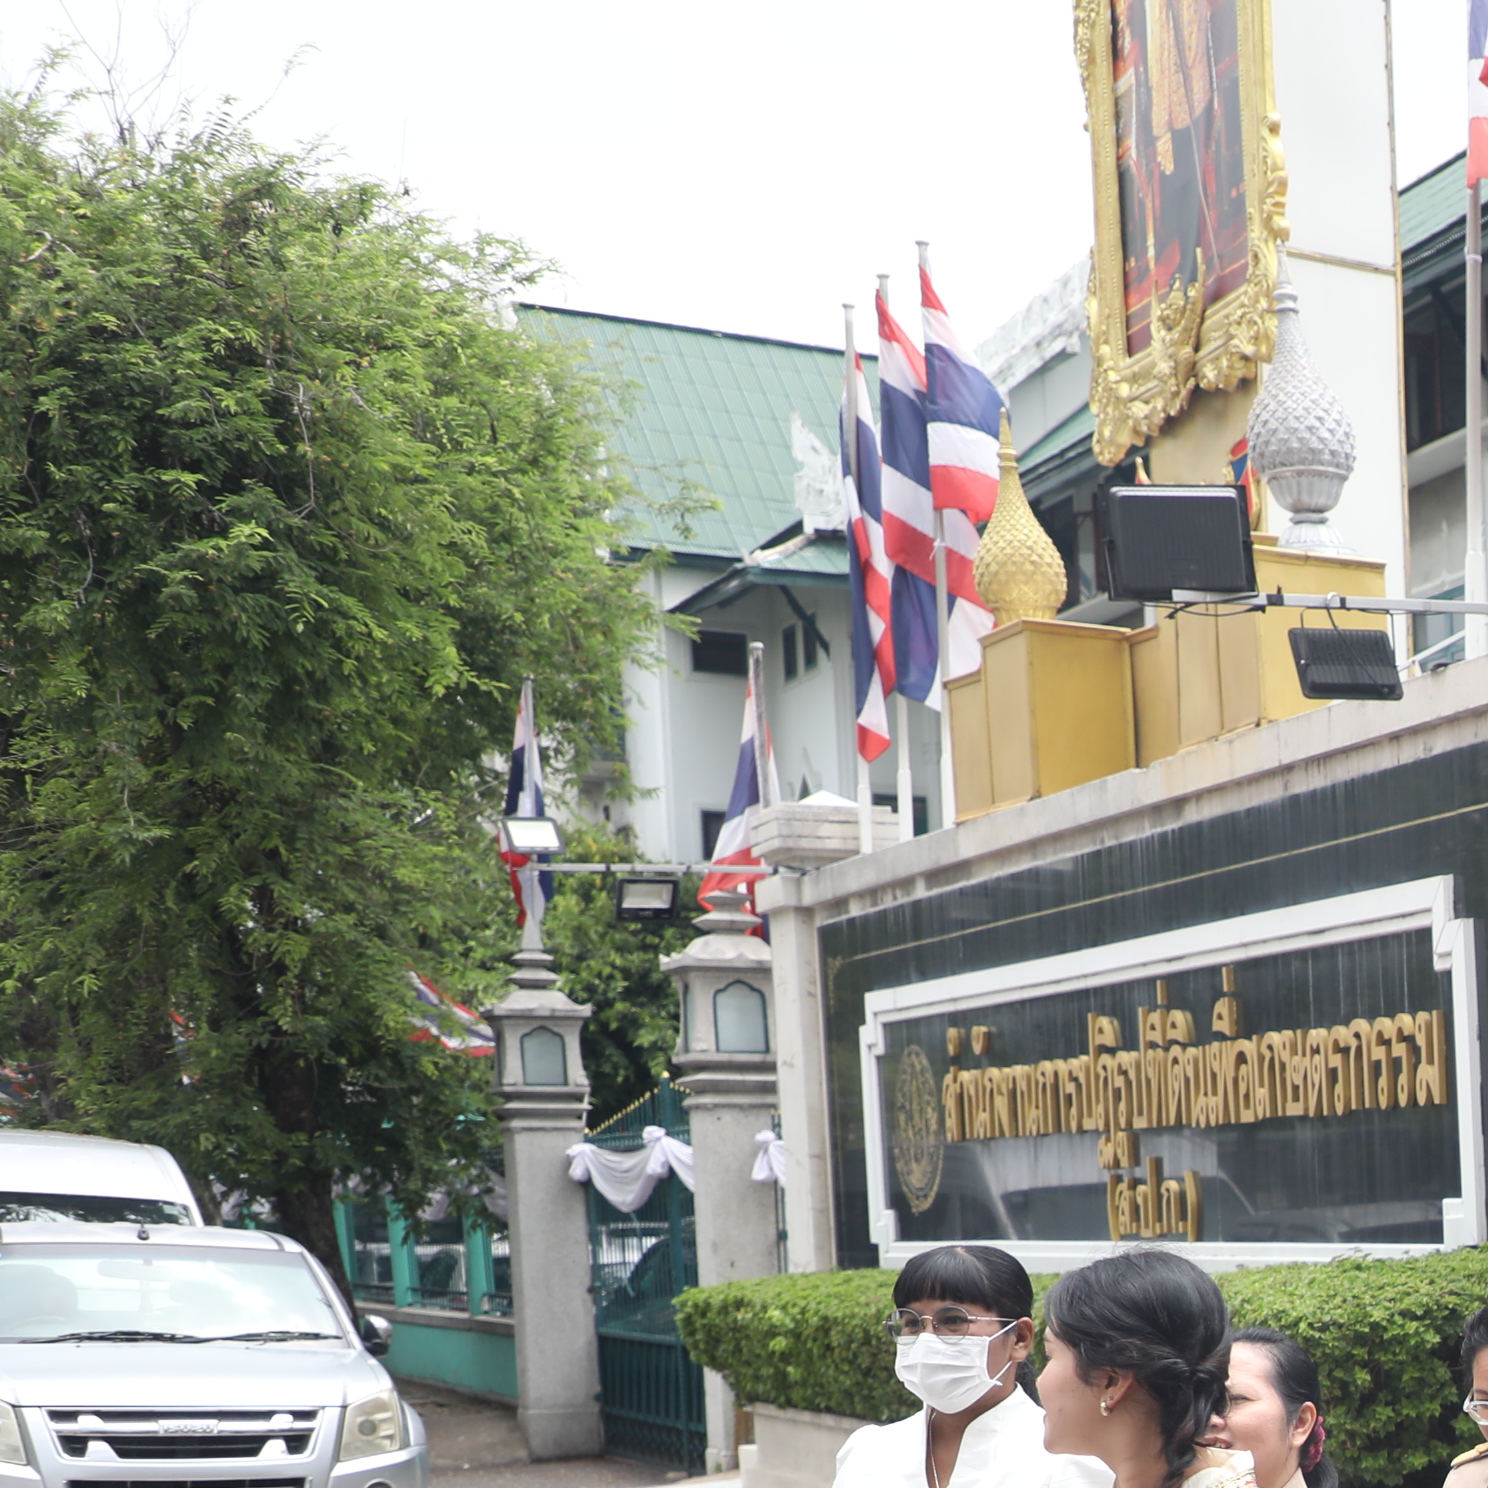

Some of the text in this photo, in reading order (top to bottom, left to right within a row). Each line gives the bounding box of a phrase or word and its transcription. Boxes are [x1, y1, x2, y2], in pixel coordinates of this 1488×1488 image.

[942, 966, 1448, 1168] สำนักงานการปฏิรูปที่ดินเพื่อเกษตรกรรม
[1108, 1157, 1199, 1241] (ส.ป.ก.)
